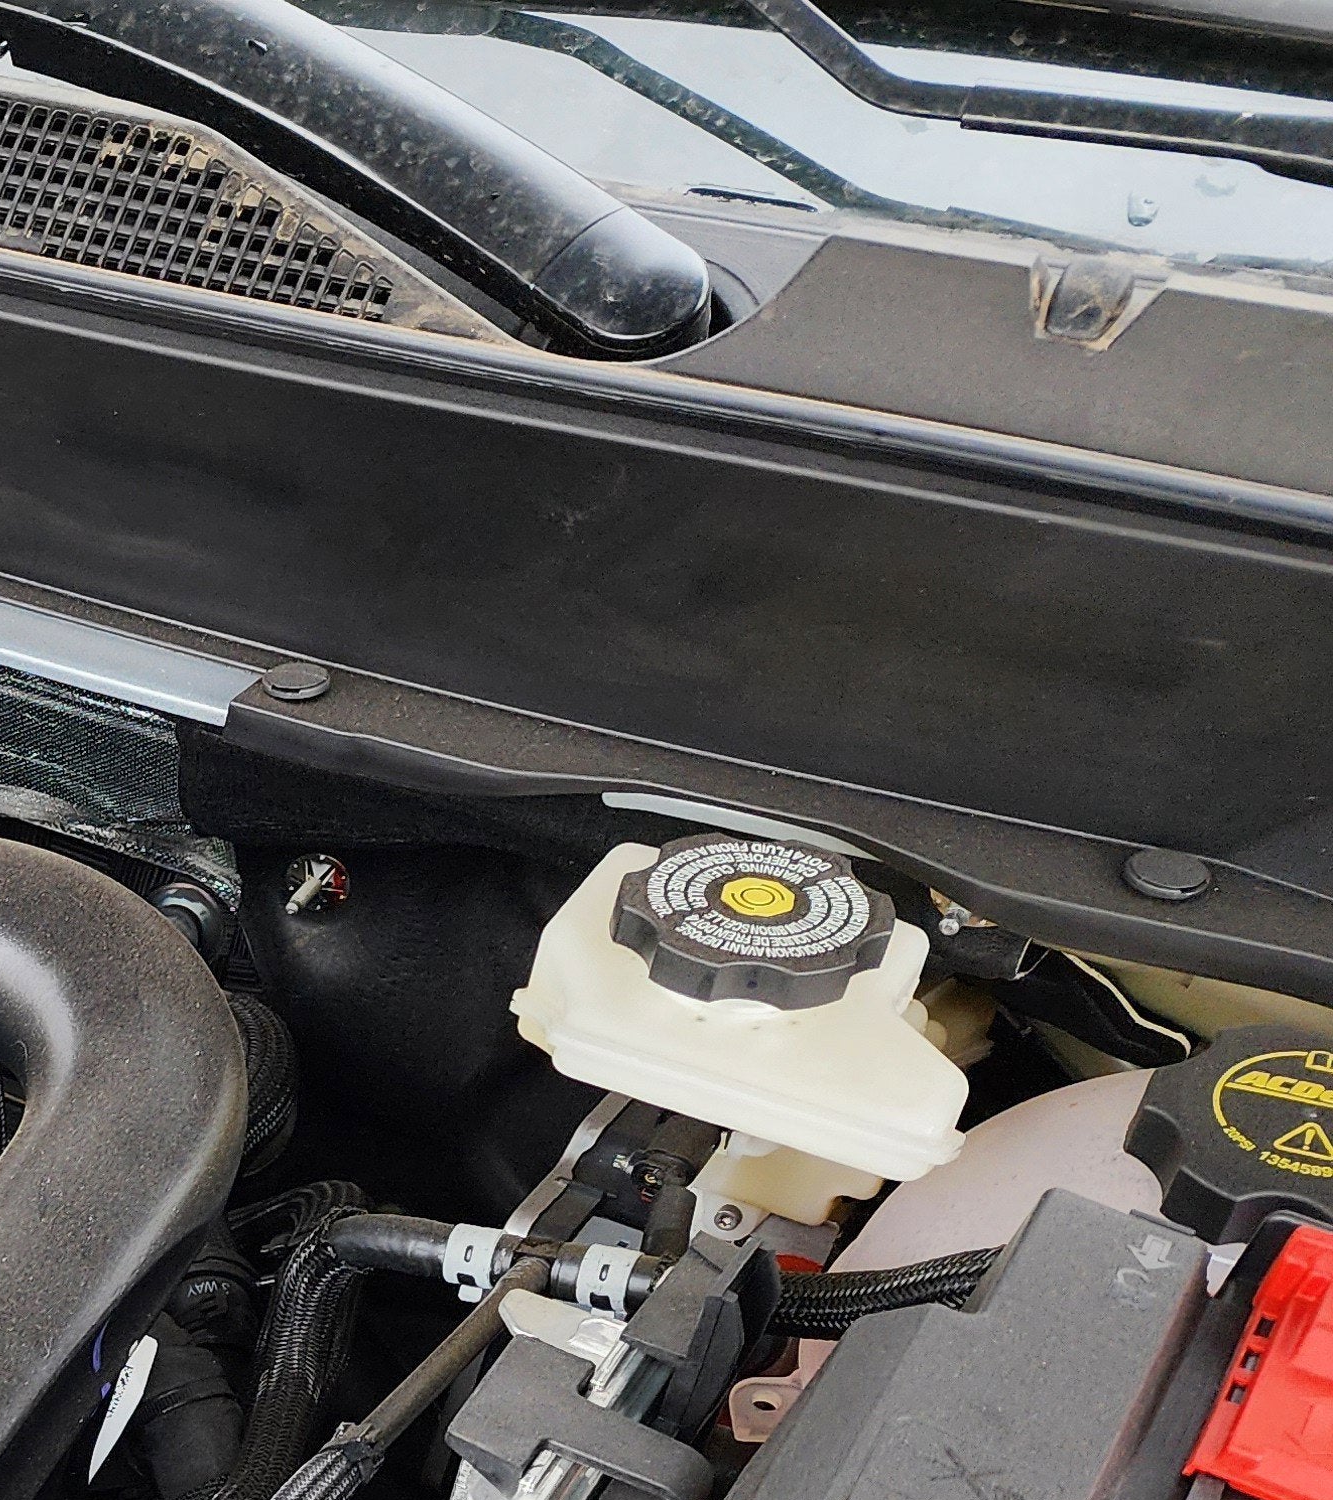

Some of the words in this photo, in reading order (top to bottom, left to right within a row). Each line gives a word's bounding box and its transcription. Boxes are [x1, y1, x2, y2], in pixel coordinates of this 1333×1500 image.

[703, 842, 748, 854] FROM
[749, 842, 794, 857] FLUID
[655, 848, 701, 874] SEALED
[730, 852, 791, 867] BEFORE
[786, 860, 822, 878] CAP
[667, 891, 692, 912] ONLY
[710, 927, 751, 945] FREIN
[750, 936, 770, 946] DE
[718, 941, 764, 956] AVANT
[765, 942, 827, 957] BOUCHON
[187, 1280, 218, 1298] WAY
